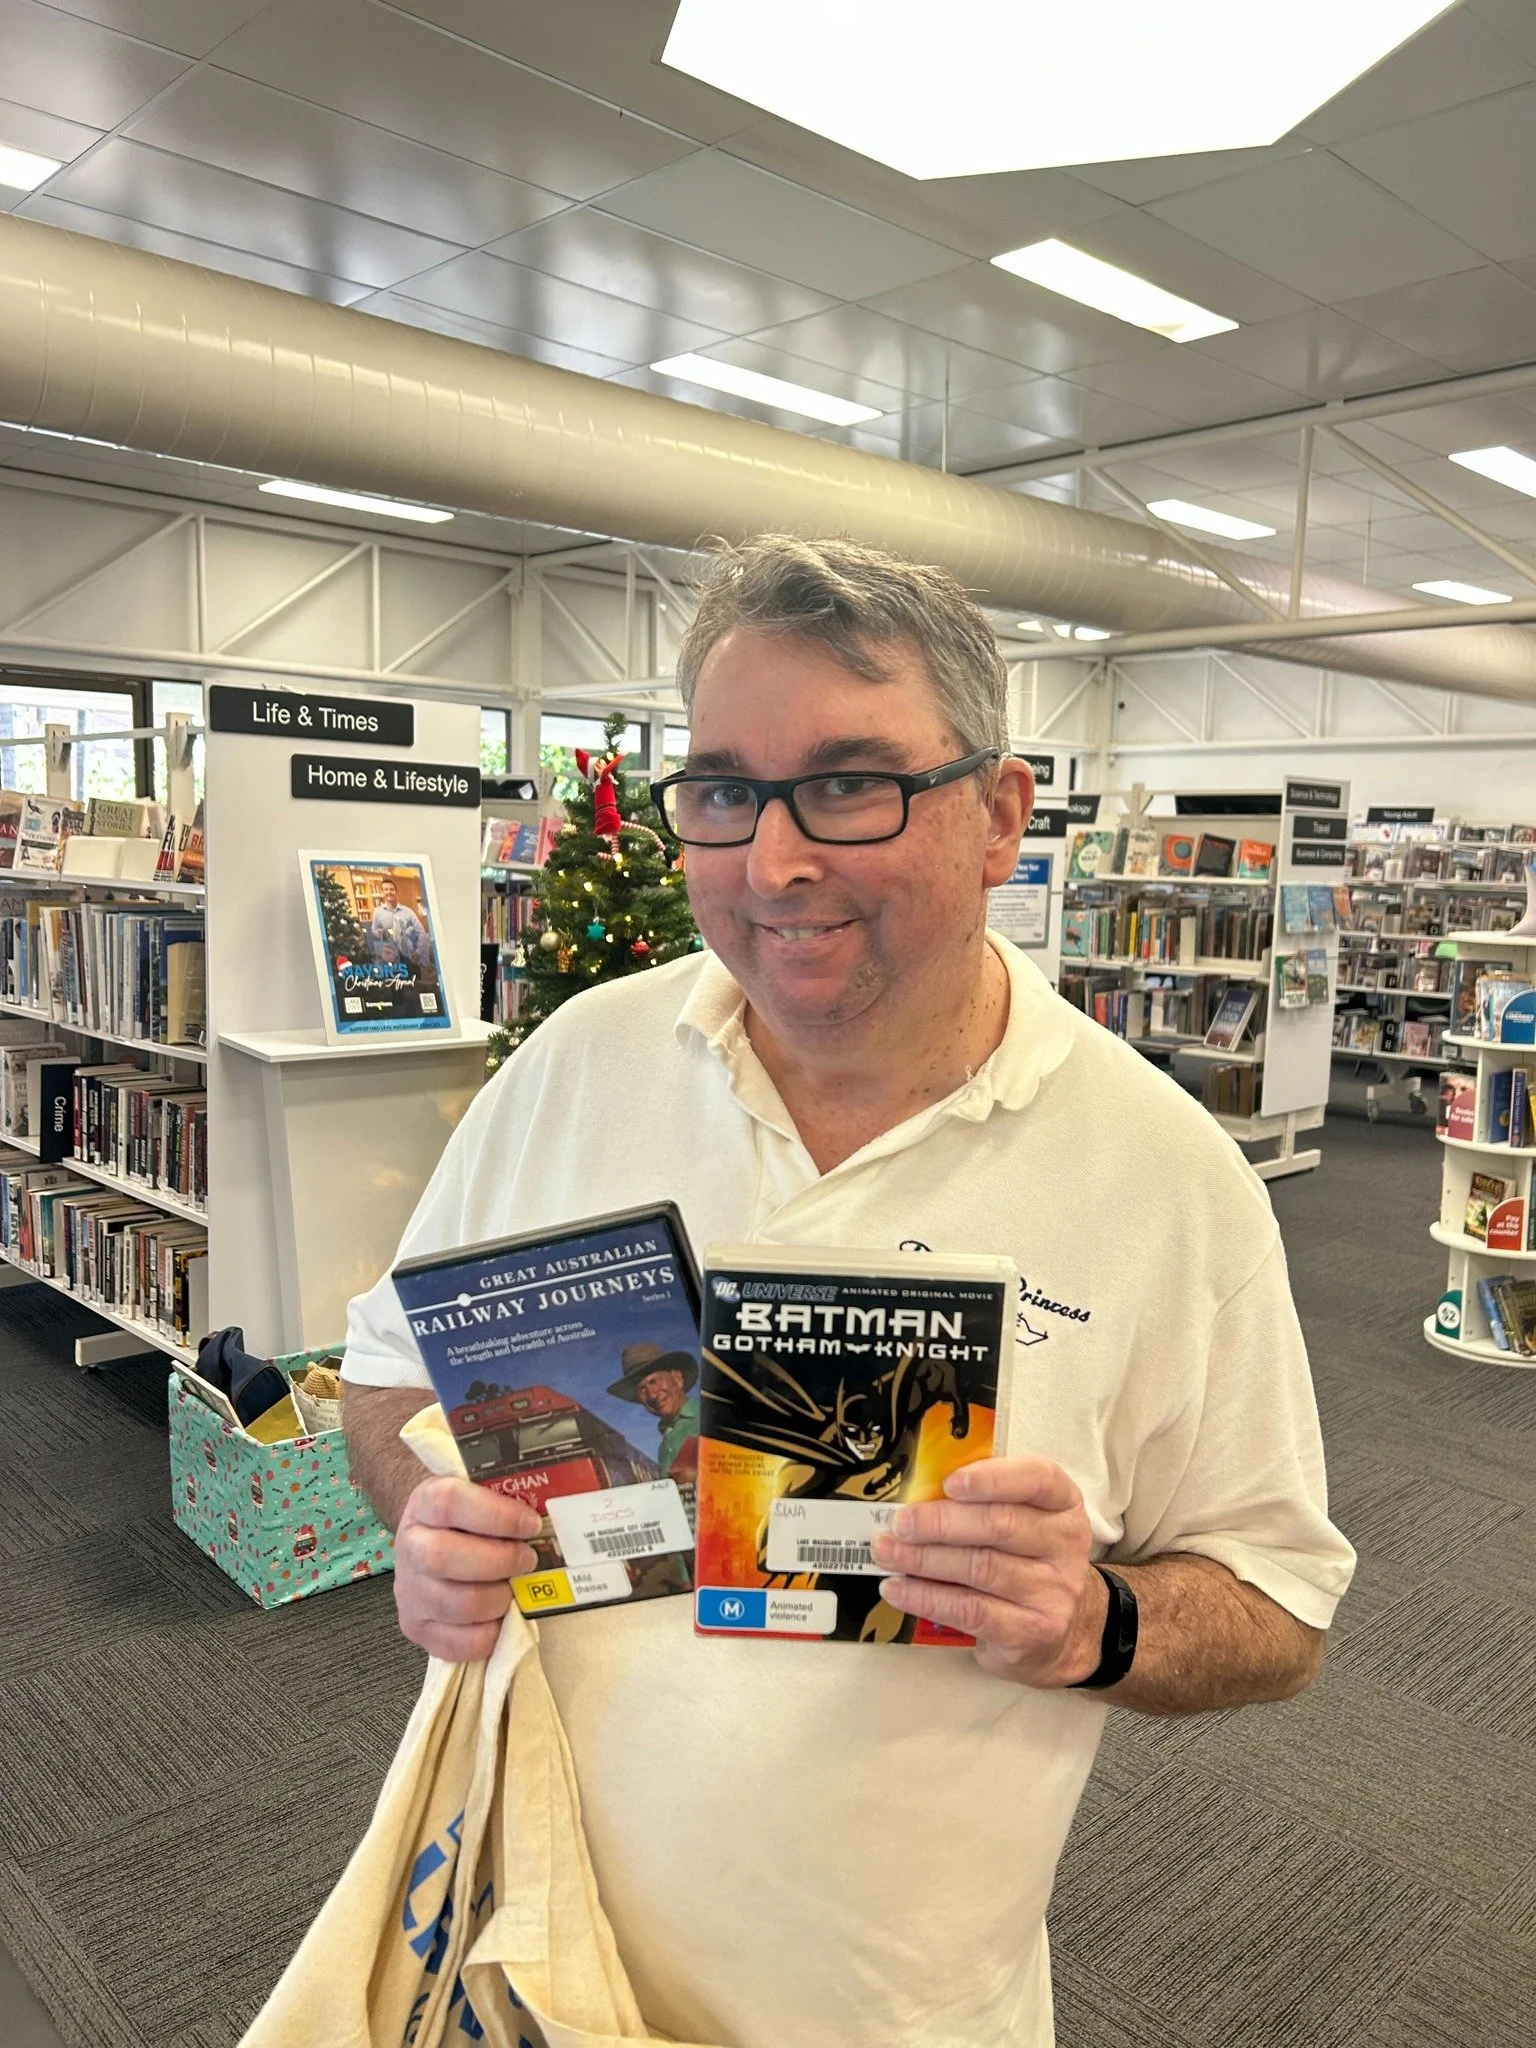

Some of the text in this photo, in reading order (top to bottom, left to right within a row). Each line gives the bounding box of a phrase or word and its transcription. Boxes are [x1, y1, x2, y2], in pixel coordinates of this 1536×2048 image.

[253, 701, 379, 732] Life & Times
[308, 764, 468, 797] Home & Lifestyle
[98, 805, 136, 817] GREAT
[1028, 816, 1050, 830] Craft
[1313, 821, 1331, 834] Travel
[342, 962, 408, 978] MAYOR'S
[345, 974, 416, 991] Christmas Appeal
[54, 1096, 67, 1132] Crime
[1505, 1214, 1520, 1223] Pay
[479, 1239, 657, 1290] GREAT AUSTRALIAN
[715, 1281, 994, 1302] DC UNIVERSE ANIMATED ORIGINAL MOVIE
[412, 1266, 675, 1337] RAILWAY JOURNEYS
[736, 1301, 964, 1340] BATMAN
[1441, 1307, 1457, 1323] $2
[447, 1321, 584, 1357] A breathtaking adventure across
[450, 1327, 596, 1366] the length and breadth of Australia
[712, 1333, 989, 1362] GOTHAM KNIGHT
[502, 1472, 550, 1495] GHAN
[603, 1497, 614, 1509] 2
[589, 1507, 635, 1523] DISCS
[572, 1572, 592, 1583] Mild
[531, 1583, 554, 1598] PG
[575, 1583, 608, 1595] themes
[724, 1600, 813, 1618] M Animated
[770, 1611, 808, 1622] violence
